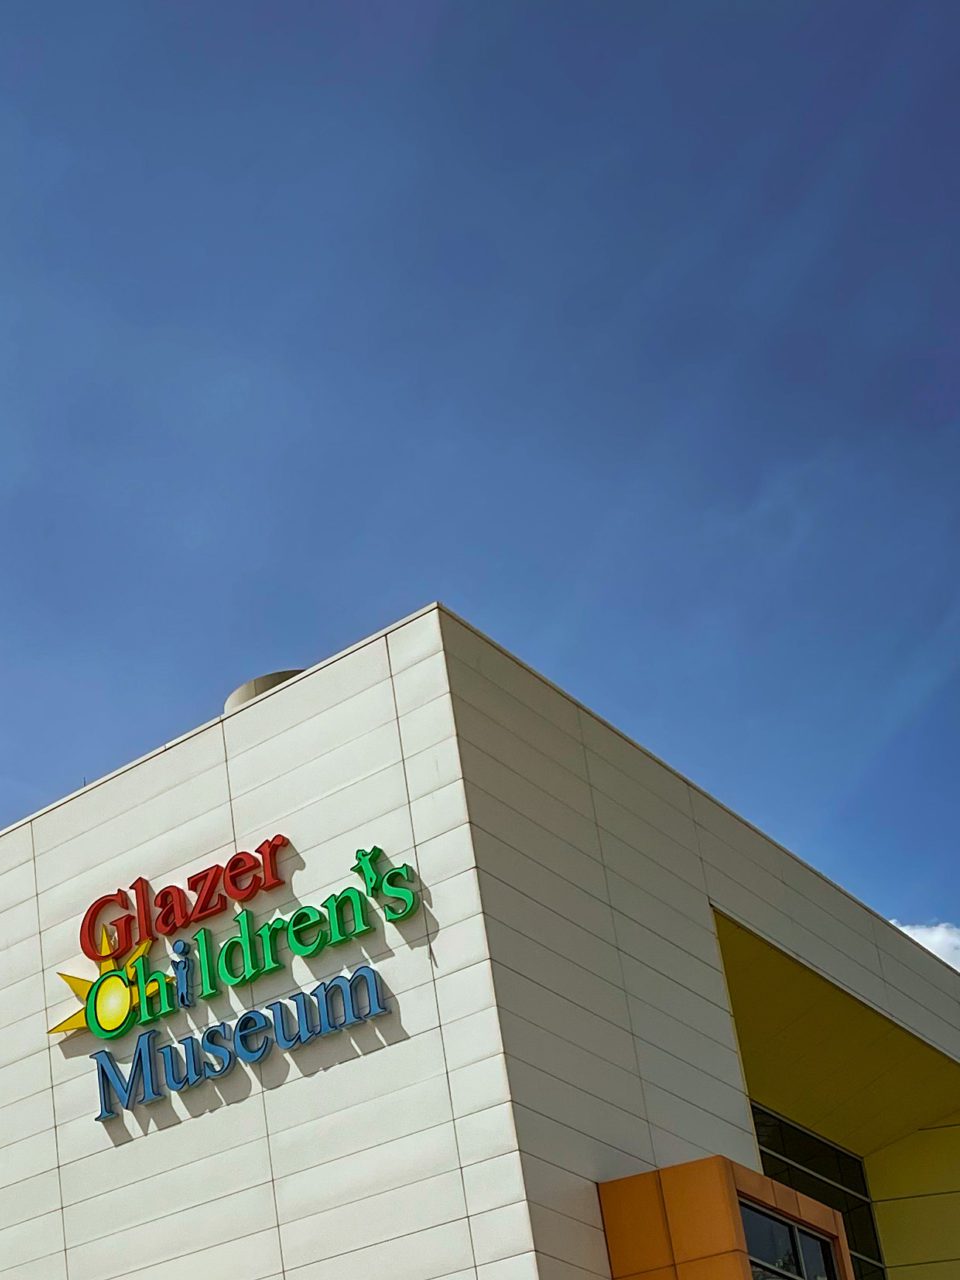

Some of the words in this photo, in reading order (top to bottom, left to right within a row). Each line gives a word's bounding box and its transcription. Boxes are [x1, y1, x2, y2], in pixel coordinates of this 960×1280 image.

[79, 833, 289, 963] Glazer
[84, 845, 421, 1040] Children's
[89, 964, 392, 1122] Museum
